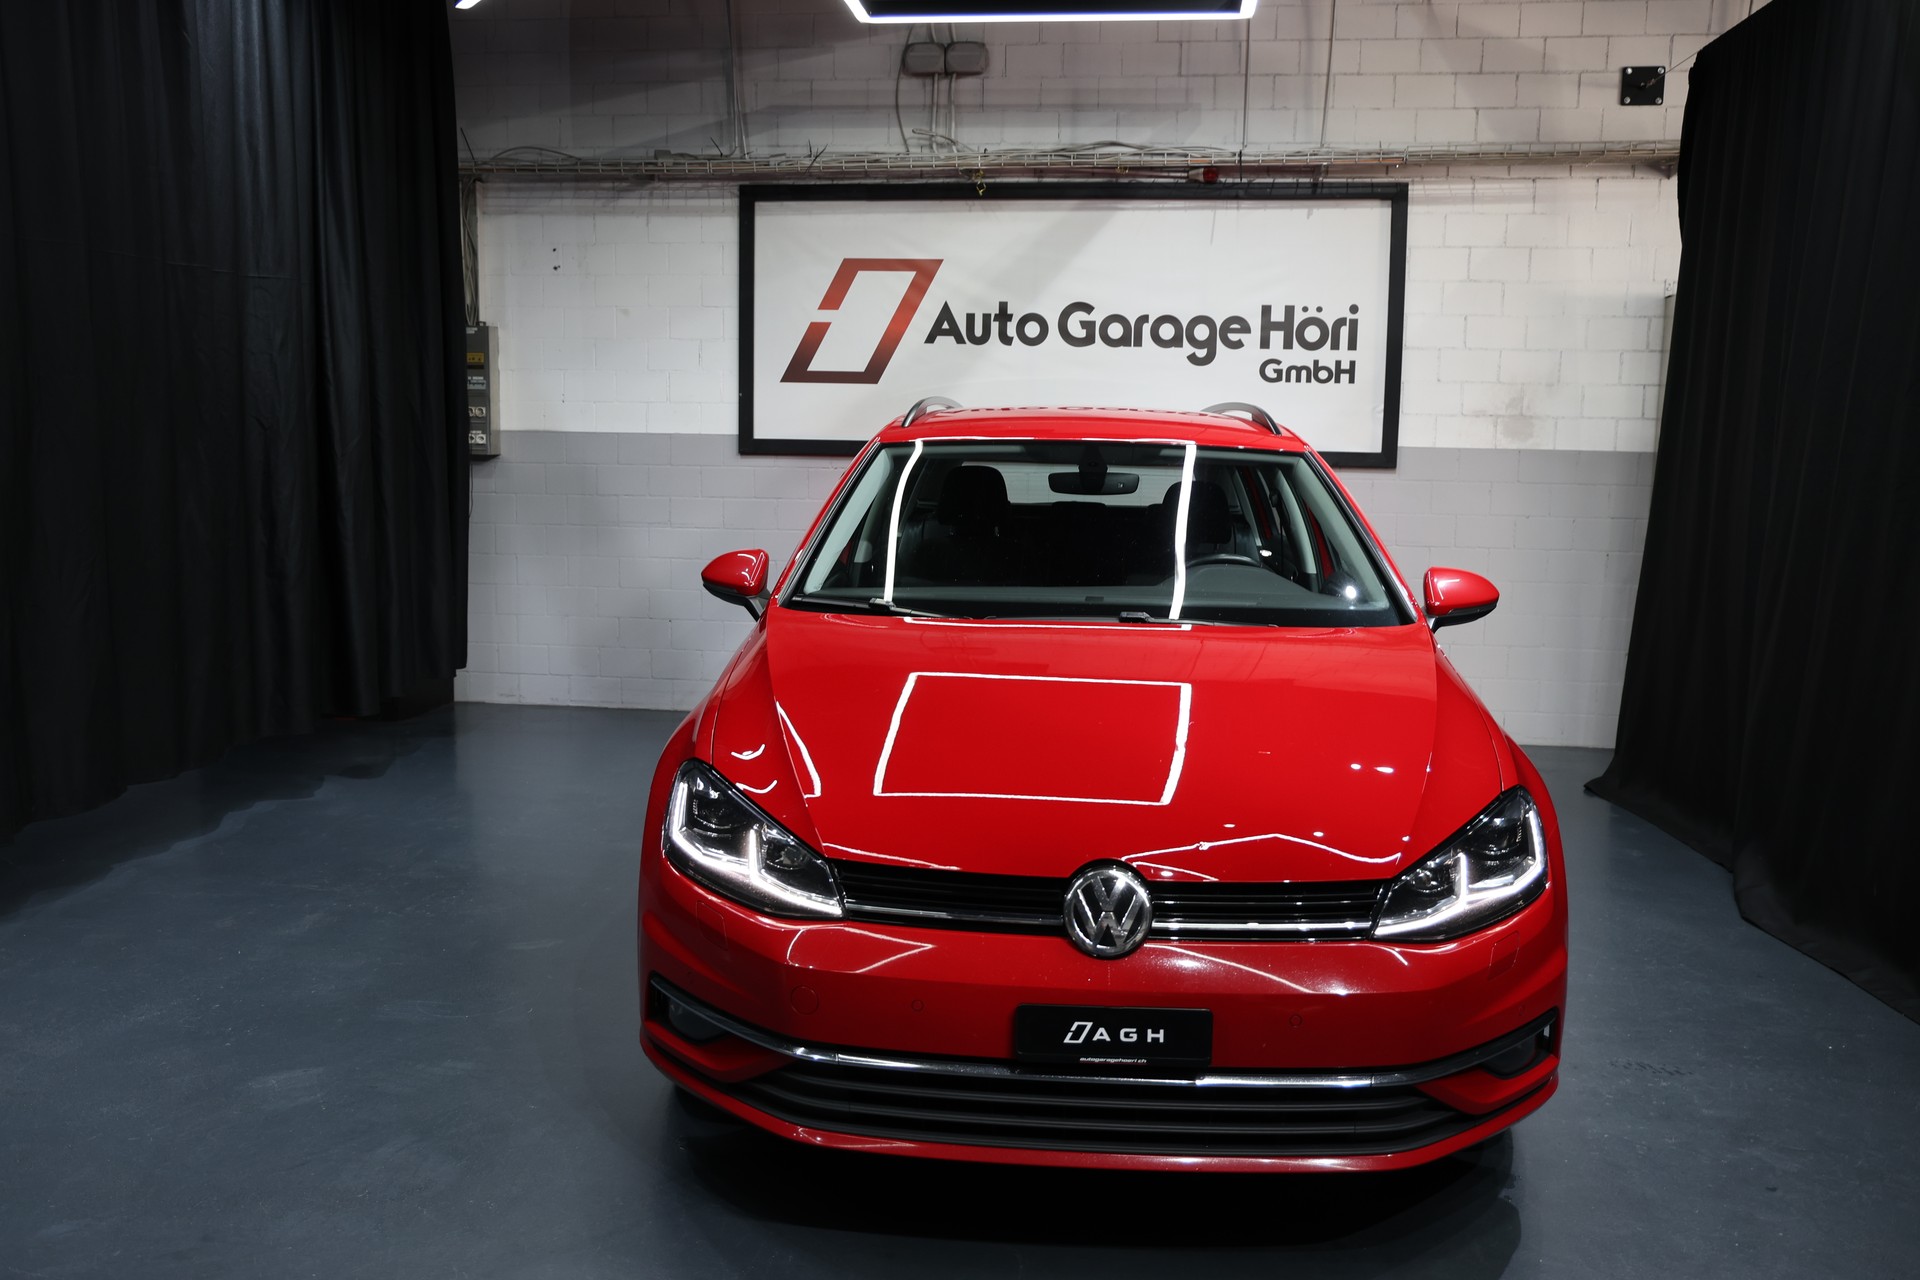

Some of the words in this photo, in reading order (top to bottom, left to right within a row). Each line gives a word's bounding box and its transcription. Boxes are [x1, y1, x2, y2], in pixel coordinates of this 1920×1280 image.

[923, 300, 1049, 347] Auto
[1057, 301, 1252, 367] Garage
[1259, 303, 1359, 352] Höri
[1259, 358, 1356, 384] GmbH
[1069, 870, 1148, 952] VW
